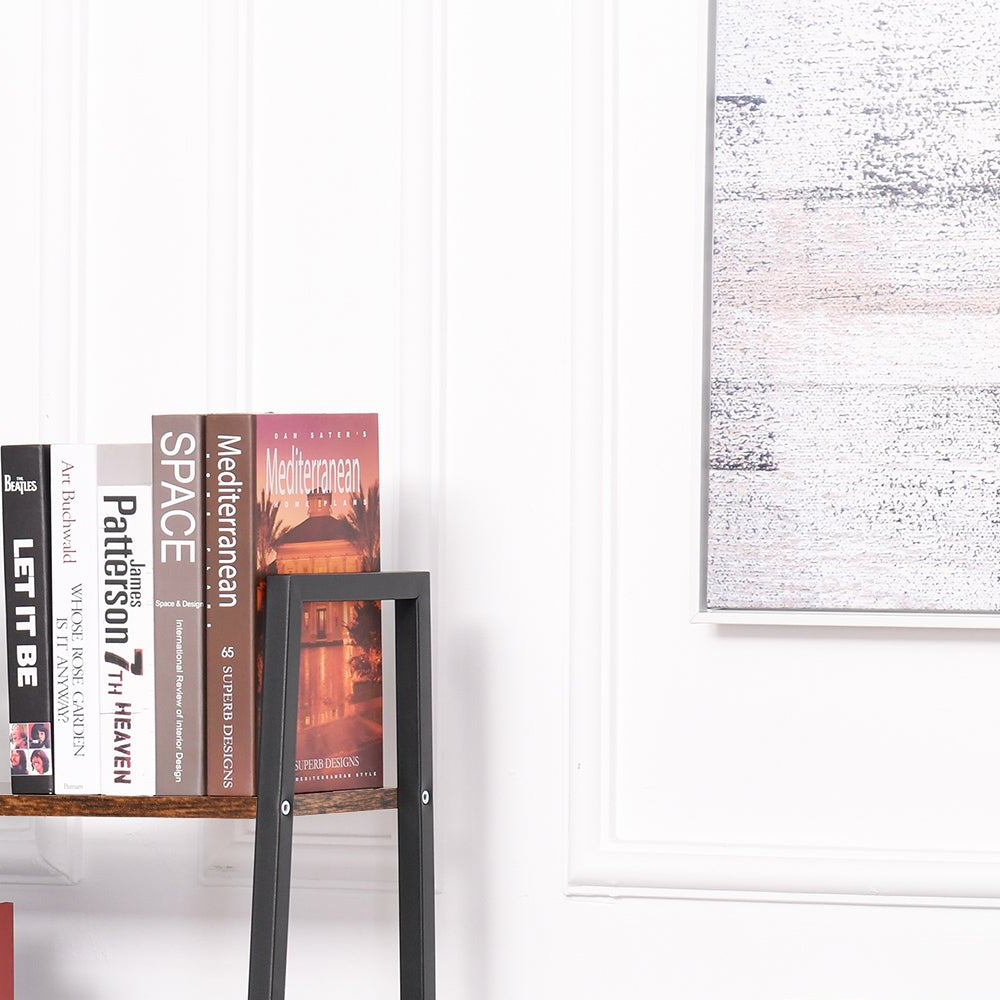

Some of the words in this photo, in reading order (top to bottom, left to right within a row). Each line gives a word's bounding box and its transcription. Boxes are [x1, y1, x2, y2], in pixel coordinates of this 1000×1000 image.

[274, 432, 298, 440] DAN
[61, 460, 75, 485] Art
[265, 445, 361, 495] Mediterranean
[160, 431, 196, 563] SPACE
[217, 434, 243, 608] Mediterranean
[62, 490, 77, 564] Buchwald
[13, 538, 36, 599] LET
[103, 496, 137, 644] Patterson
[129, 559, 146, 608] James
[15, 606, 36, 637] IT
[56, 618, 68, 629] IS
[71, 583, 83, 641] WHOSE
[155, 600, 175, 608] Space
[16, 645, 38, 688] BE
[56, 636, 69, 651] IT
[71, 647, 85, 685] ROSE
[175, 619, 183, 673] International
[221, 646, 234, 658] 65
[56, 656, 70, 724] ANYWAY?
[175, 675, 184, 707] Review
[175, 709, 183, 718] of
[222, 665, 234, 721] SUPERB
[72, 691, 85, 757] GARDEN
[113, 702, 132, 784] HEAVEN
[174, 752, 184, 783] Design
[222, 724, 234, 789] DESIGNS
[325, 756, 360, 769] DESIGNS
